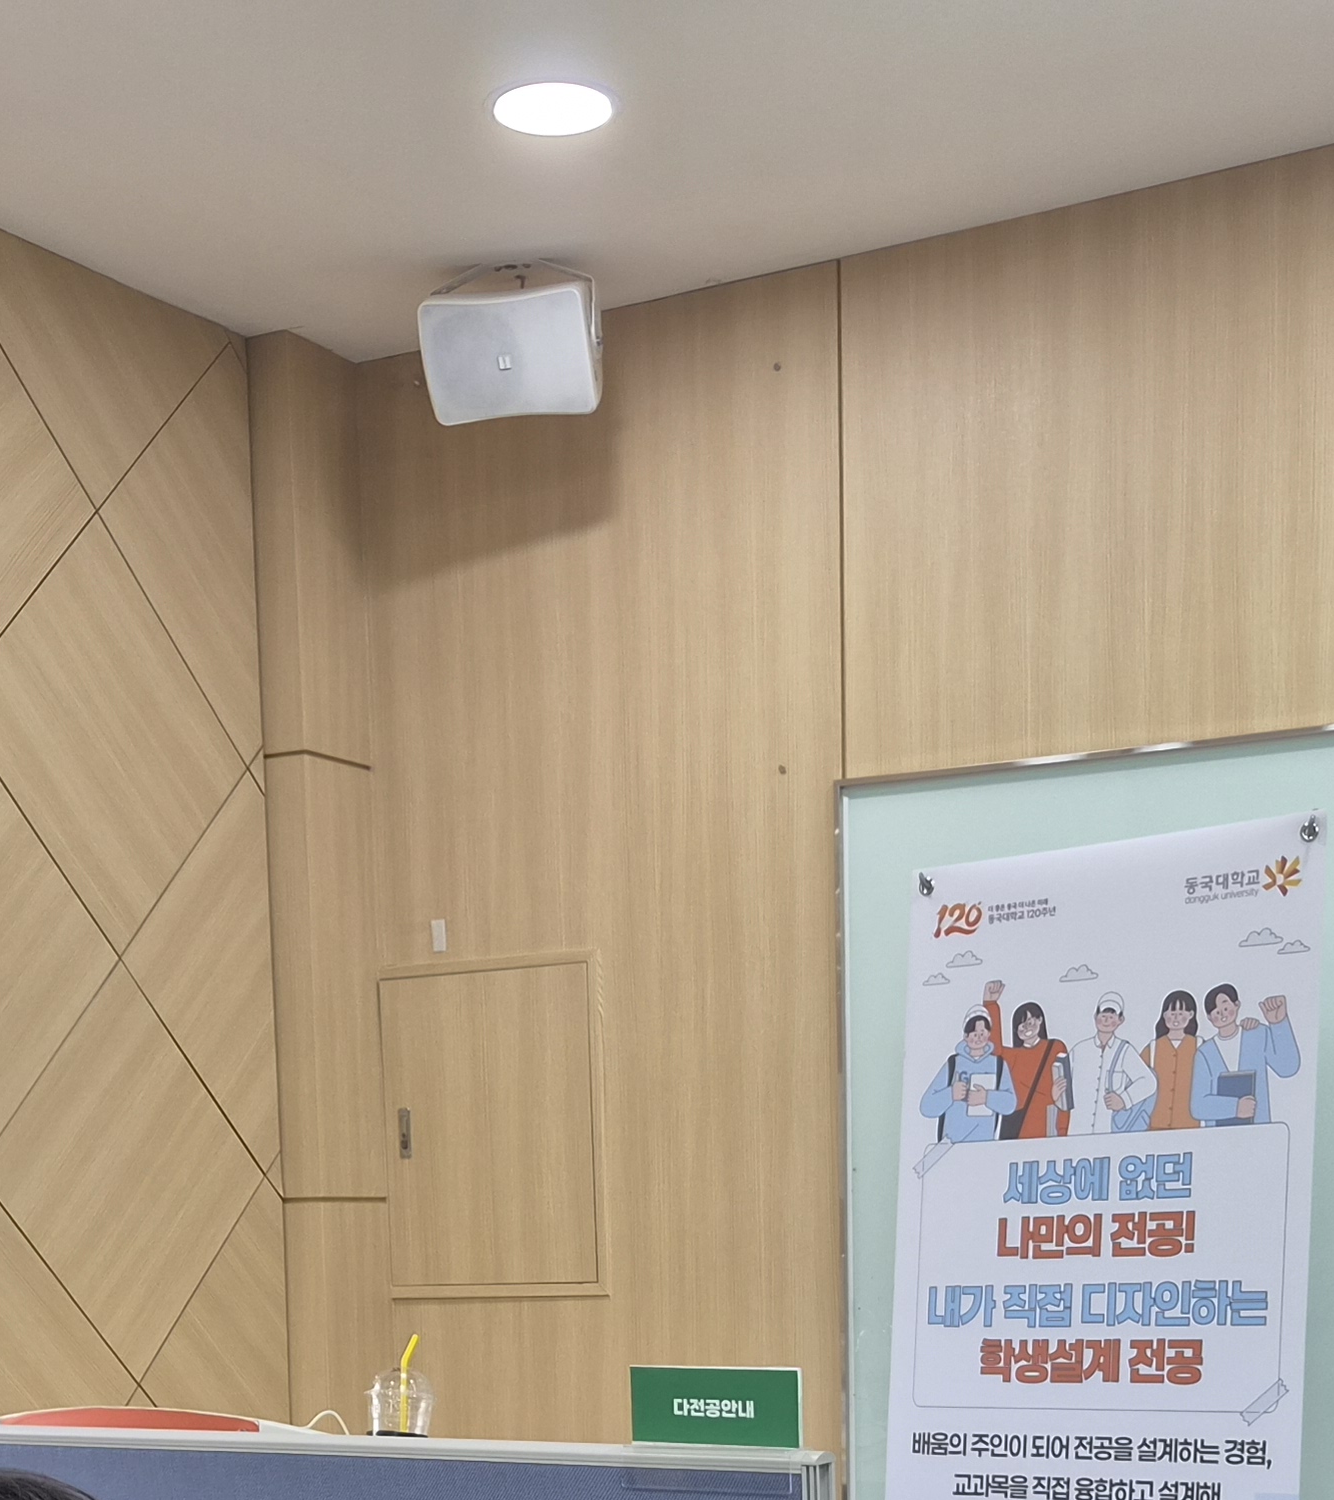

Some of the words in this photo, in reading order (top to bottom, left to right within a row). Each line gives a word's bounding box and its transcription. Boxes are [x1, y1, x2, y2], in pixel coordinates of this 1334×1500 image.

[1184, 869, 1260, 895] 동국대학교
[1002, 1156, 1111, 1206] 세상에
[1118, 1151, 1193, 1202] 없던
[996, 1213, 1103, 1260] 나만의
[1110, 1210, 1196, 1258] 전공!
[927, 1284, 997, 1328] 내가
[1002, 1282, 1073, 1329] 직접
[1080, 1279, 1269, 1327] 디자인하는
[980, 1338, 1122, 1384] 학생설계
[1128, 1338, 1204, 1386] 전공
[672, 1397, 755, 1419] 다전공안내
[912, 1432, 968, 1457] 배움의
[970, 1433, 1028, 1459] 주인이
[1030, 1435, 1070, 1460] 되어
[1073, 1436, 1134, 1462] 전공을
[1137, 1437, 1220, 1465] 설계하는
[1224, 1439, 1272, 1470] 경험,
[952, 1473, 1029, 1500] 교과목을
[1032, 1476, 1071, 1500] 직접
